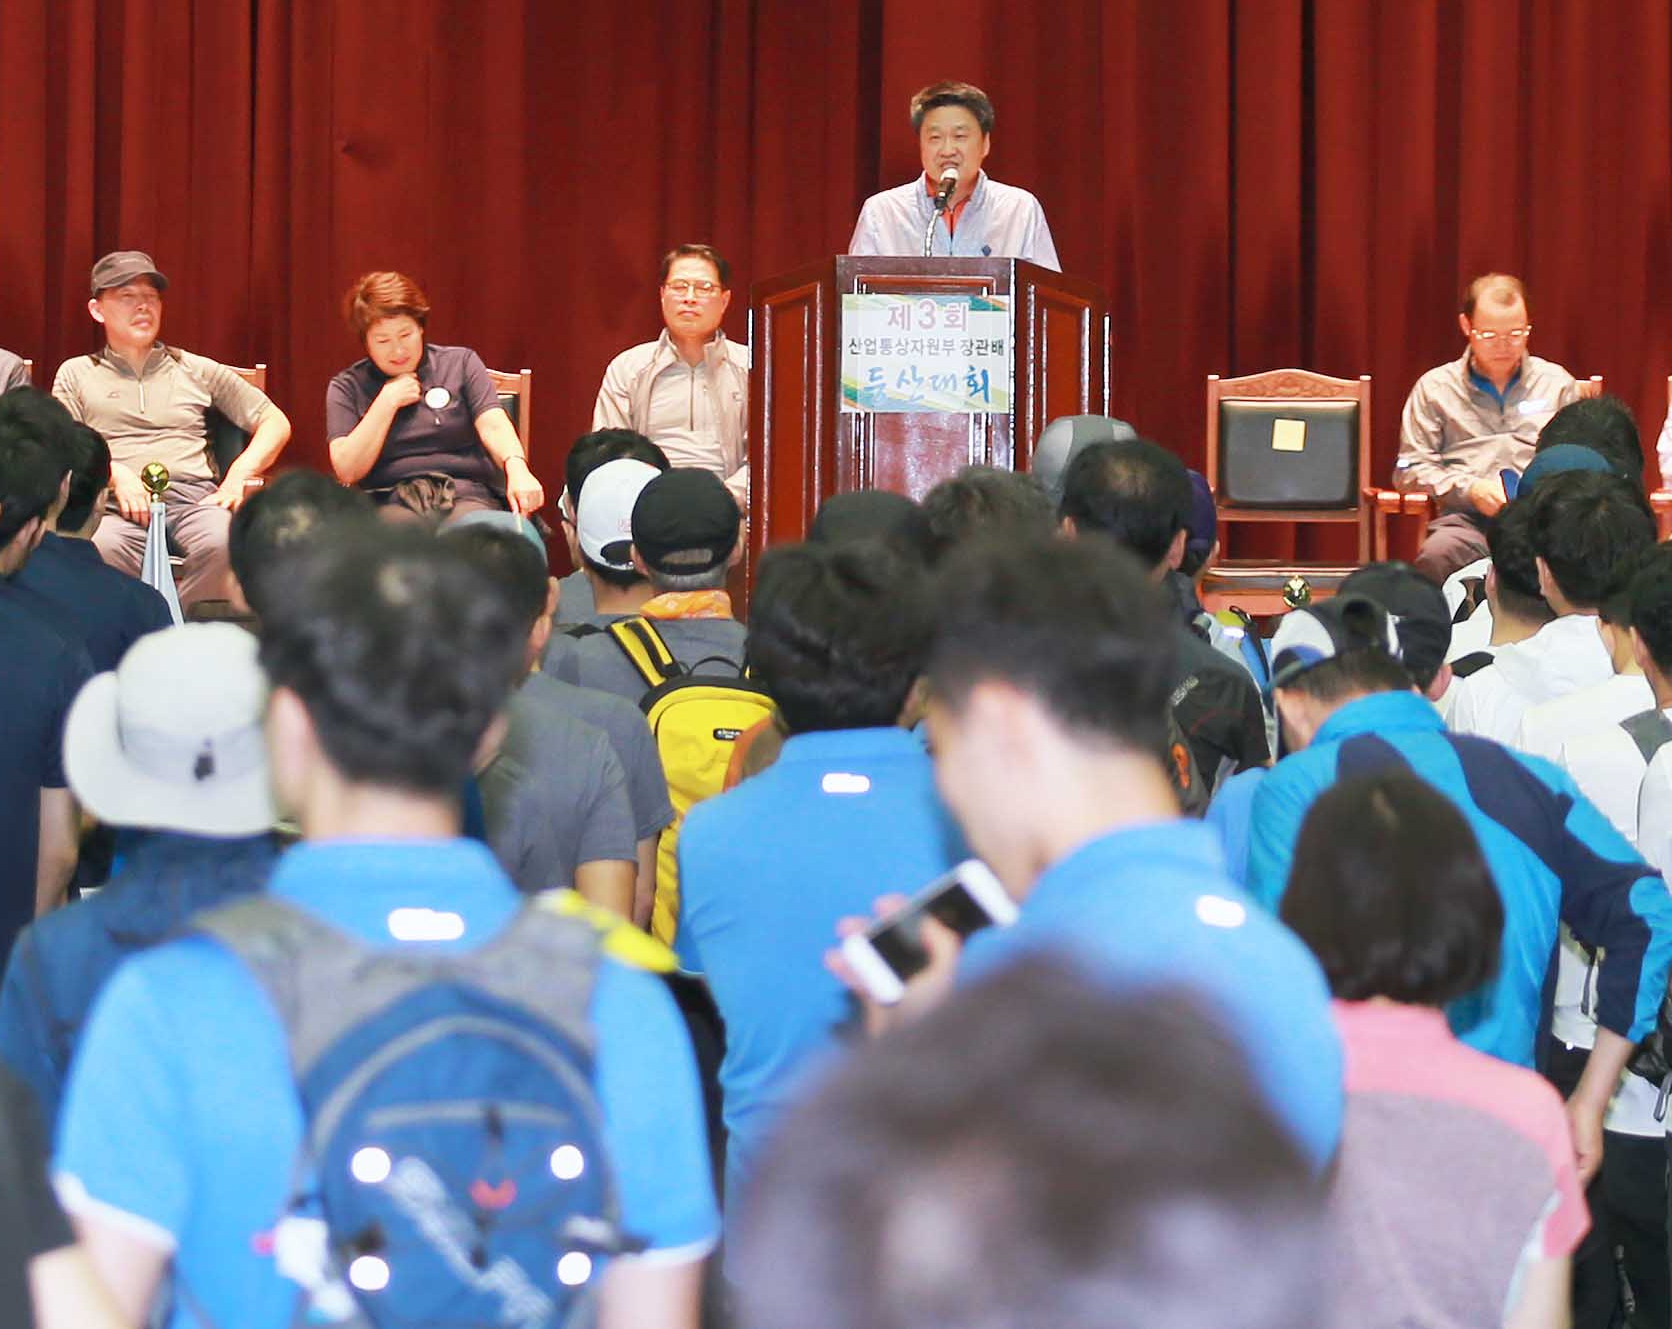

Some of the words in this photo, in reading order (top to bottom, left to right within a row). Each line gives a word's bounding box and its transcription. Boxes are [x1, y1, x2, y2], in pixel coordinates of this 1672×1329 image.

[887, 298, 969, 332] 제3회
[848, 337, 956, 357] 산업통상자원부
[959, 337, 1005, 357] 장관배
